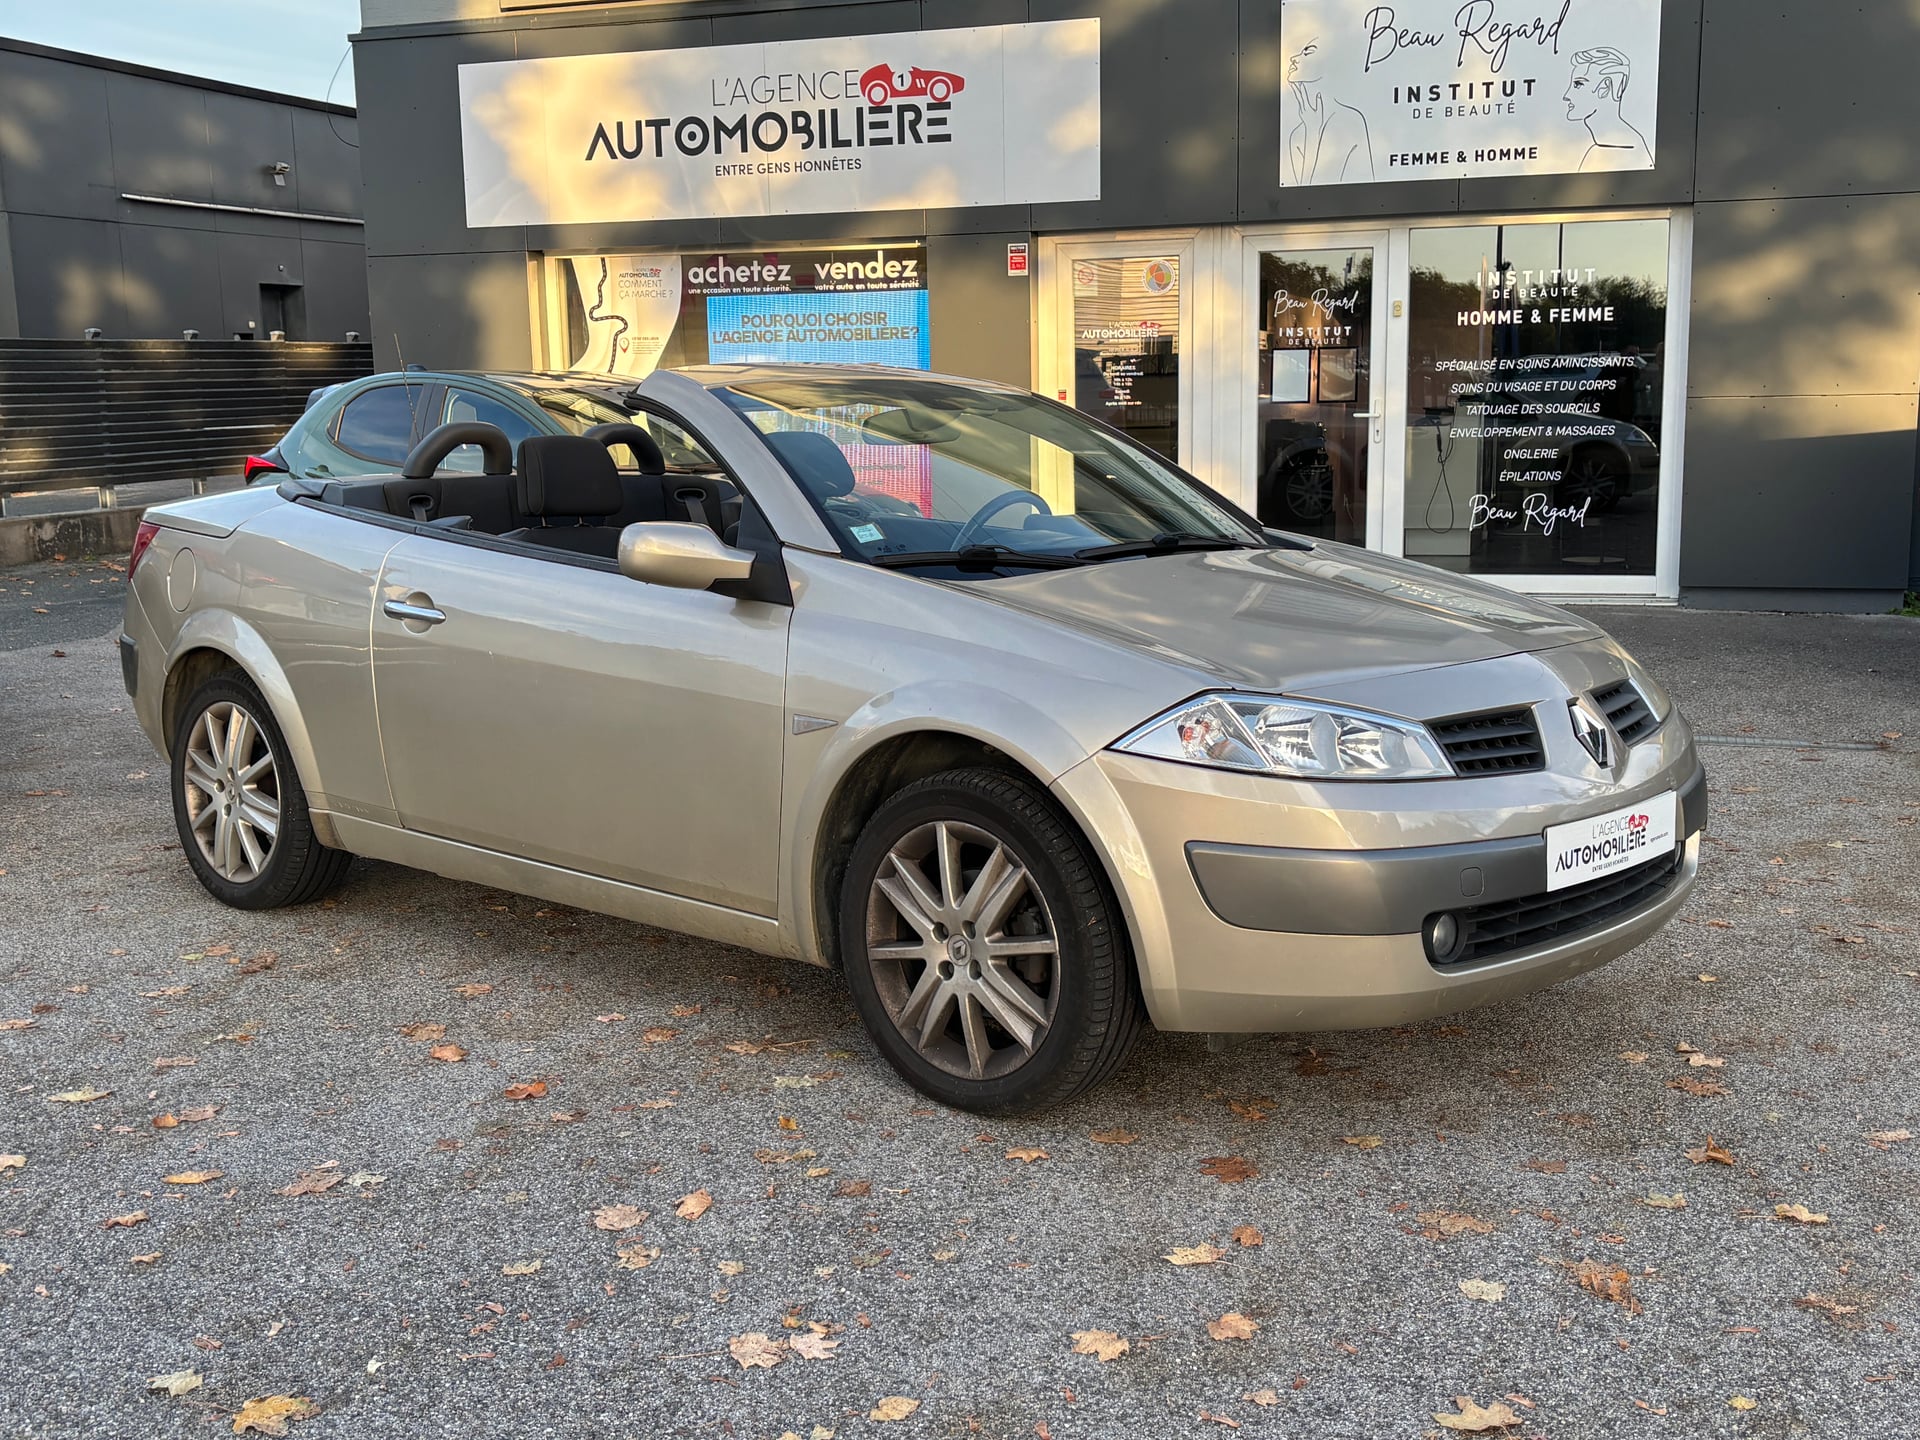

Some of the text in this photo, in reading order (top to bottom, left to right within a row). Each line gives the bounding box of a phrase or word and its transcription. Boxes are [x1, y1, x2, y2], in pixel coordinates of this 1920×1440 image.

[1364, 0, 1571, 73] Beau Regard
[711, 70, 860, 106] L'AGENCE
[1393, 79, 1536, 103] INSTITUT
[1412, 100, 1515, 119] DE BEAUTÉ
[1390, 147, 1538, 166] FEMME & HOMME
[715, 156, 862, 176] ENTRE GENS HONNÊTES
[688, 256, 791, 284] achetez
[814, 250, 918, 280] vendez
[618, 280, 663, 288] COMMENT
[1477, 268, 1596, 286] INSTITUT
[632, 289, 667, 298] MARCHE
[702, 286, 731, 294] occasion
[1492, 285, 1579, 300] DE BEAUTÉ
[1274, 288, 1359, 320] Beau Regard
[741, 312, 887, 329] POURQUOI CHOISIR
[1457, 306, 1614, 326] HOMME & FEMME
[712, 329, 785, 344] L'AGENCE
[1279, 326, 1352, 337] INSTITUT
[1305, 337, 1341, 345] BEAUTÉ
[1499, 359, 1516, 370] EN
[1516, 358, 1550, 369] SOINS
[1551, 356, 1635, 369] AMINCISSANTS
[1451, 379, 1617, 394] SOINS DU VISAGE ET DU CORPS
[1466, 402, 1601, 416] TATOUAGE DES SOURCILS
[1450, 425, 1616, 438] ENVELOPPEMENT & MASSAGES
[1503, 448, 1560, 460] ONGLERIE
[1499, 469, 1562, 482] ÉPILATIONS
[1468, 493, 1592, 536] Beau Regard
[1592, 815, 1629, 839] L'AGENCE
